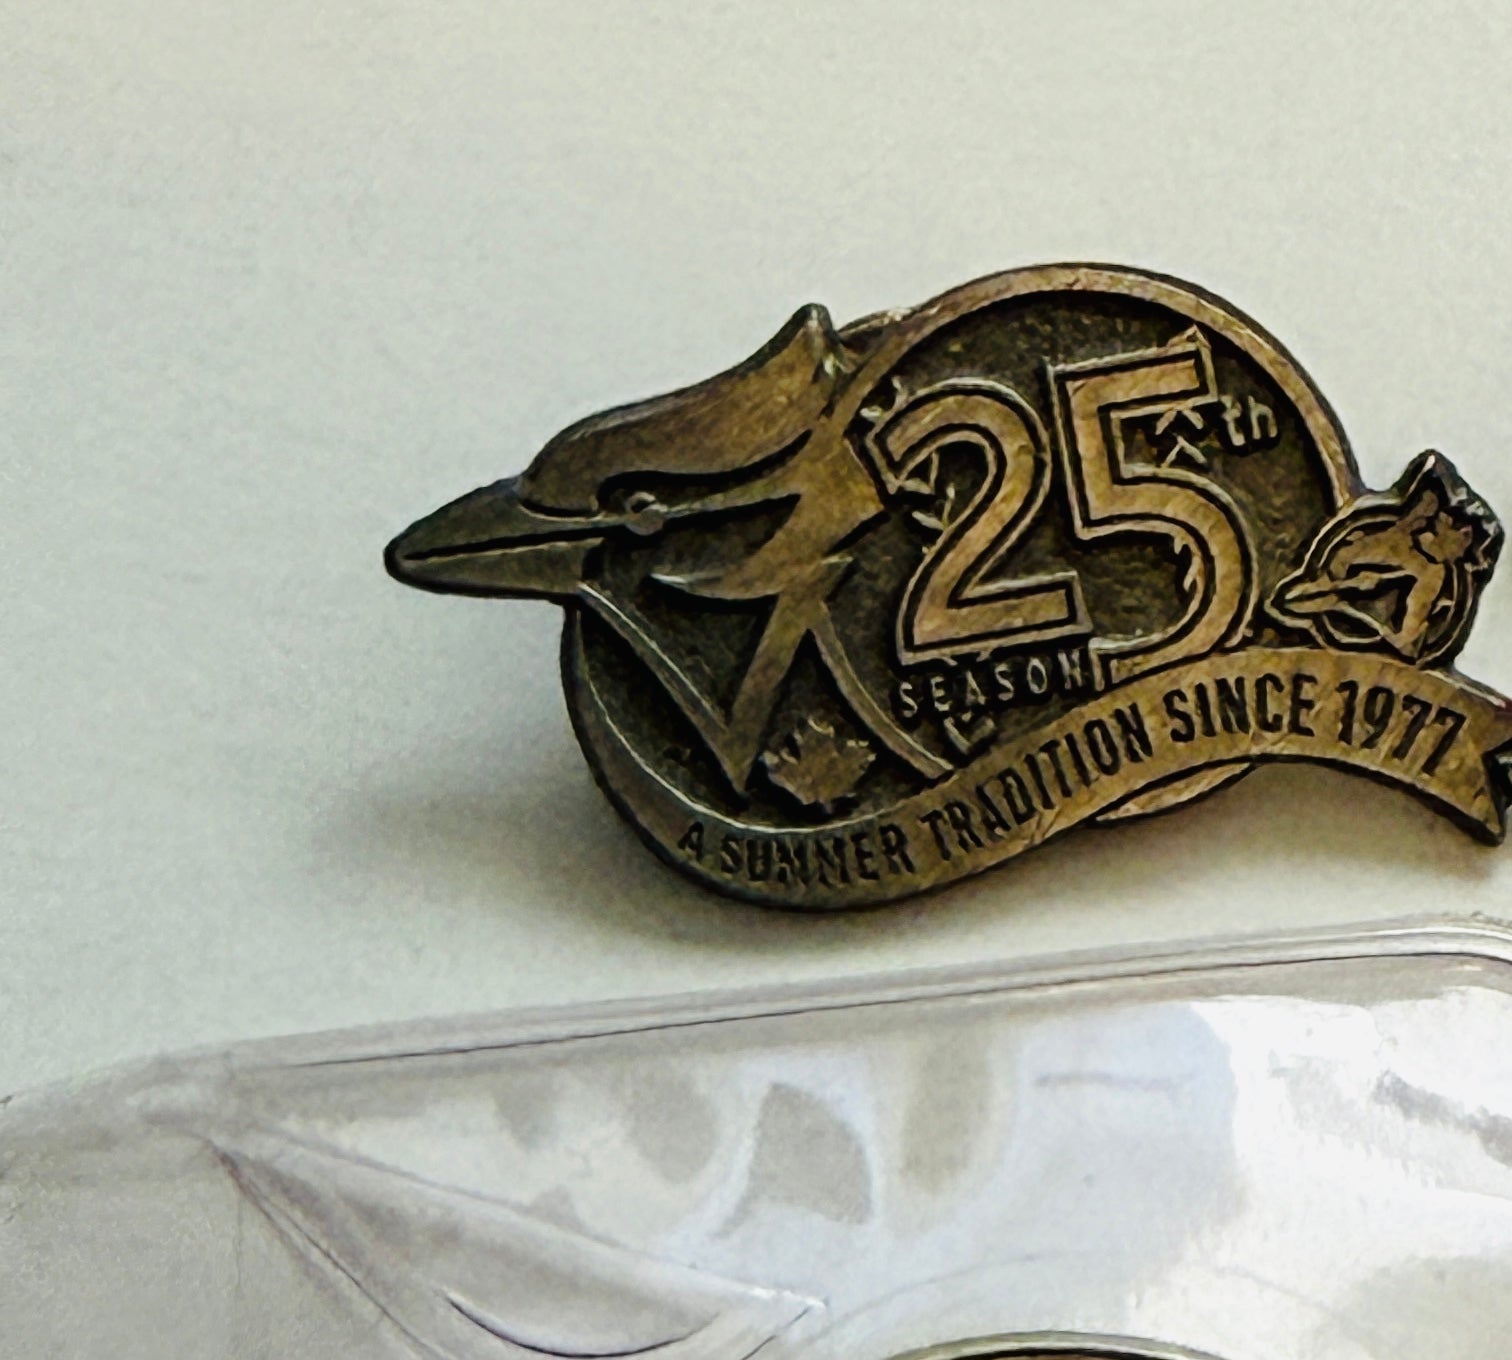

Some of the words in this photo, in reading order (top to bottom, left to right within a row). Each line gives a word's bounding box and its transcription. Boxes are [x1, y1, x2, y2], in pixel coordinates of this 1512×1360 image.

[899, 648, 1085, 719] SEASON
[677, 820, 705, 860] A
[720, 822, 916, 888] SUMMER
[919, 706, 1154, 862] TRADITION
[1168, 672, 1319, 744] SINCE
[1337, 678, 1470, 776] 1977
